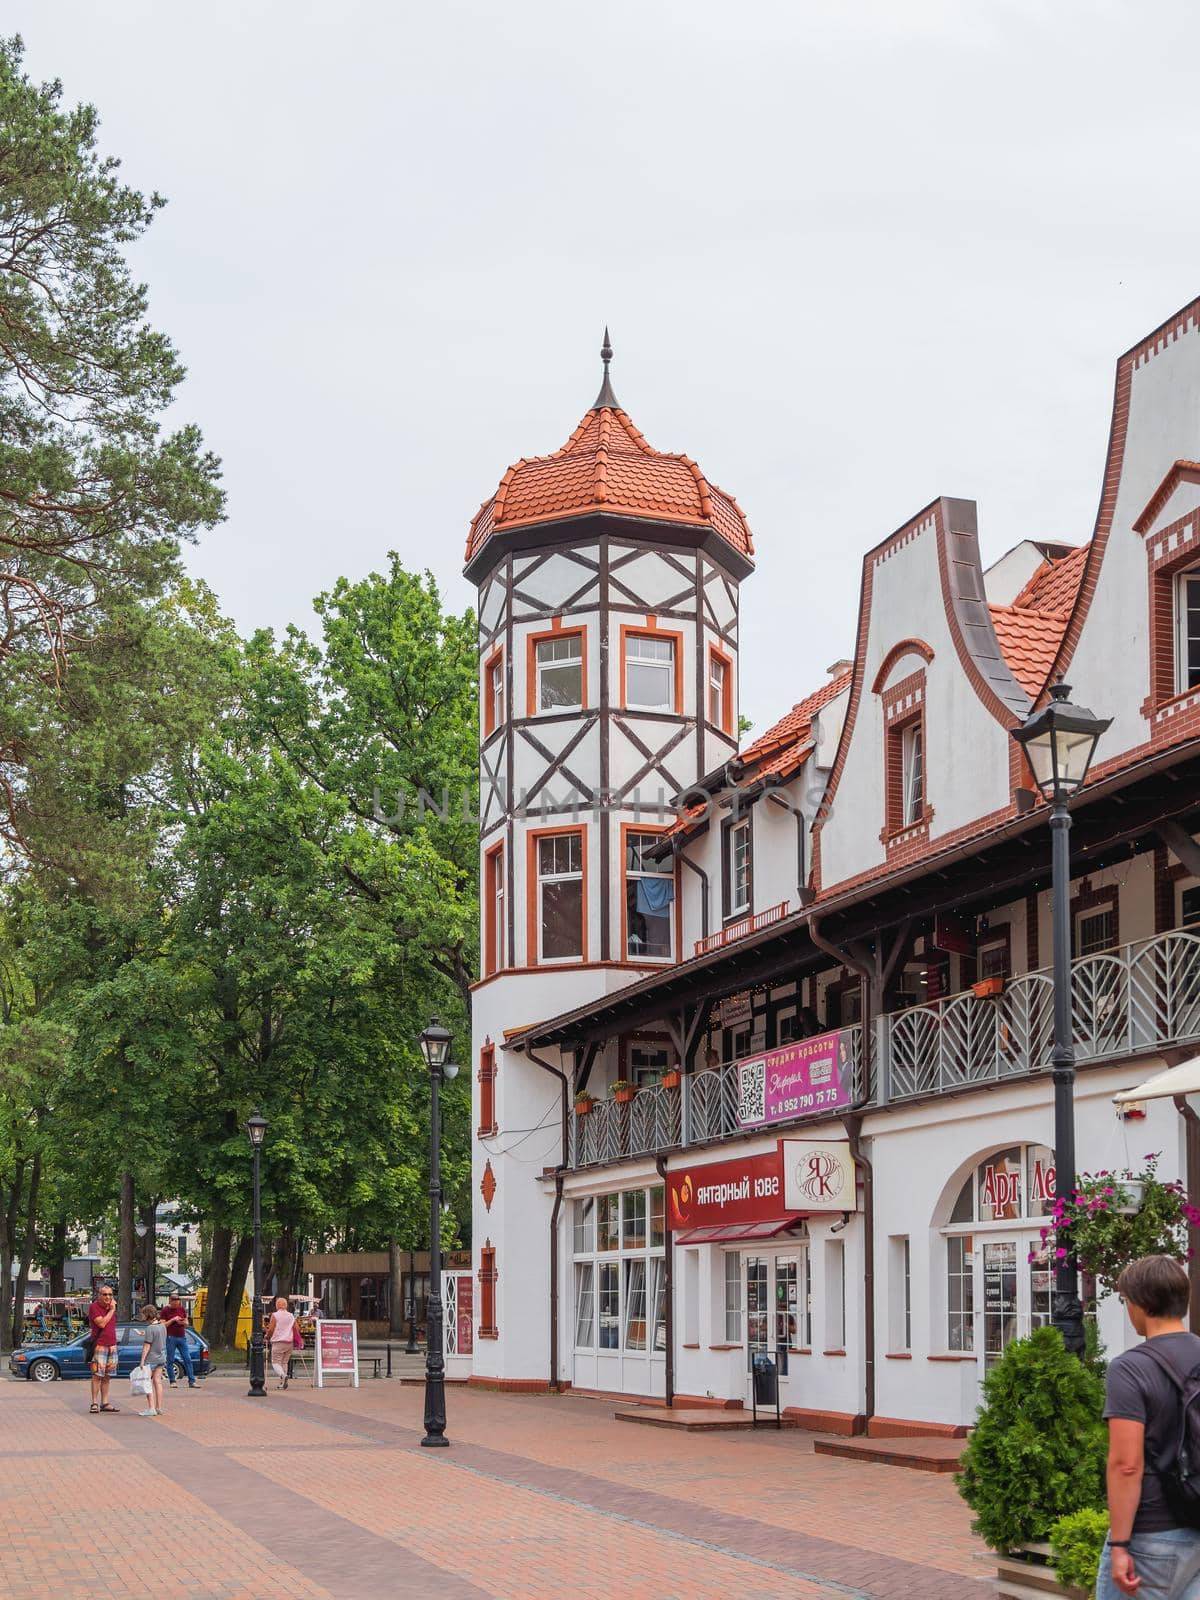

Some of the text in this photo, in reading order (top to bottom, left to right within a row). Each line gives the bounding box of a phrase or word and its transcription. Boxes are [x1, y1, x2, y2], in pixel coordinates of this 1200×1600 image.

[784, 1098, 798, 1112] 952
[799, 1094, 814, 1109] 790
[815, 1091, 824, 1105] 75
[826, 1088, 837, 1101] 75
[697, 1176, 750, 1209] янтарный
[982, 1165, 1021, 1217] Арт
